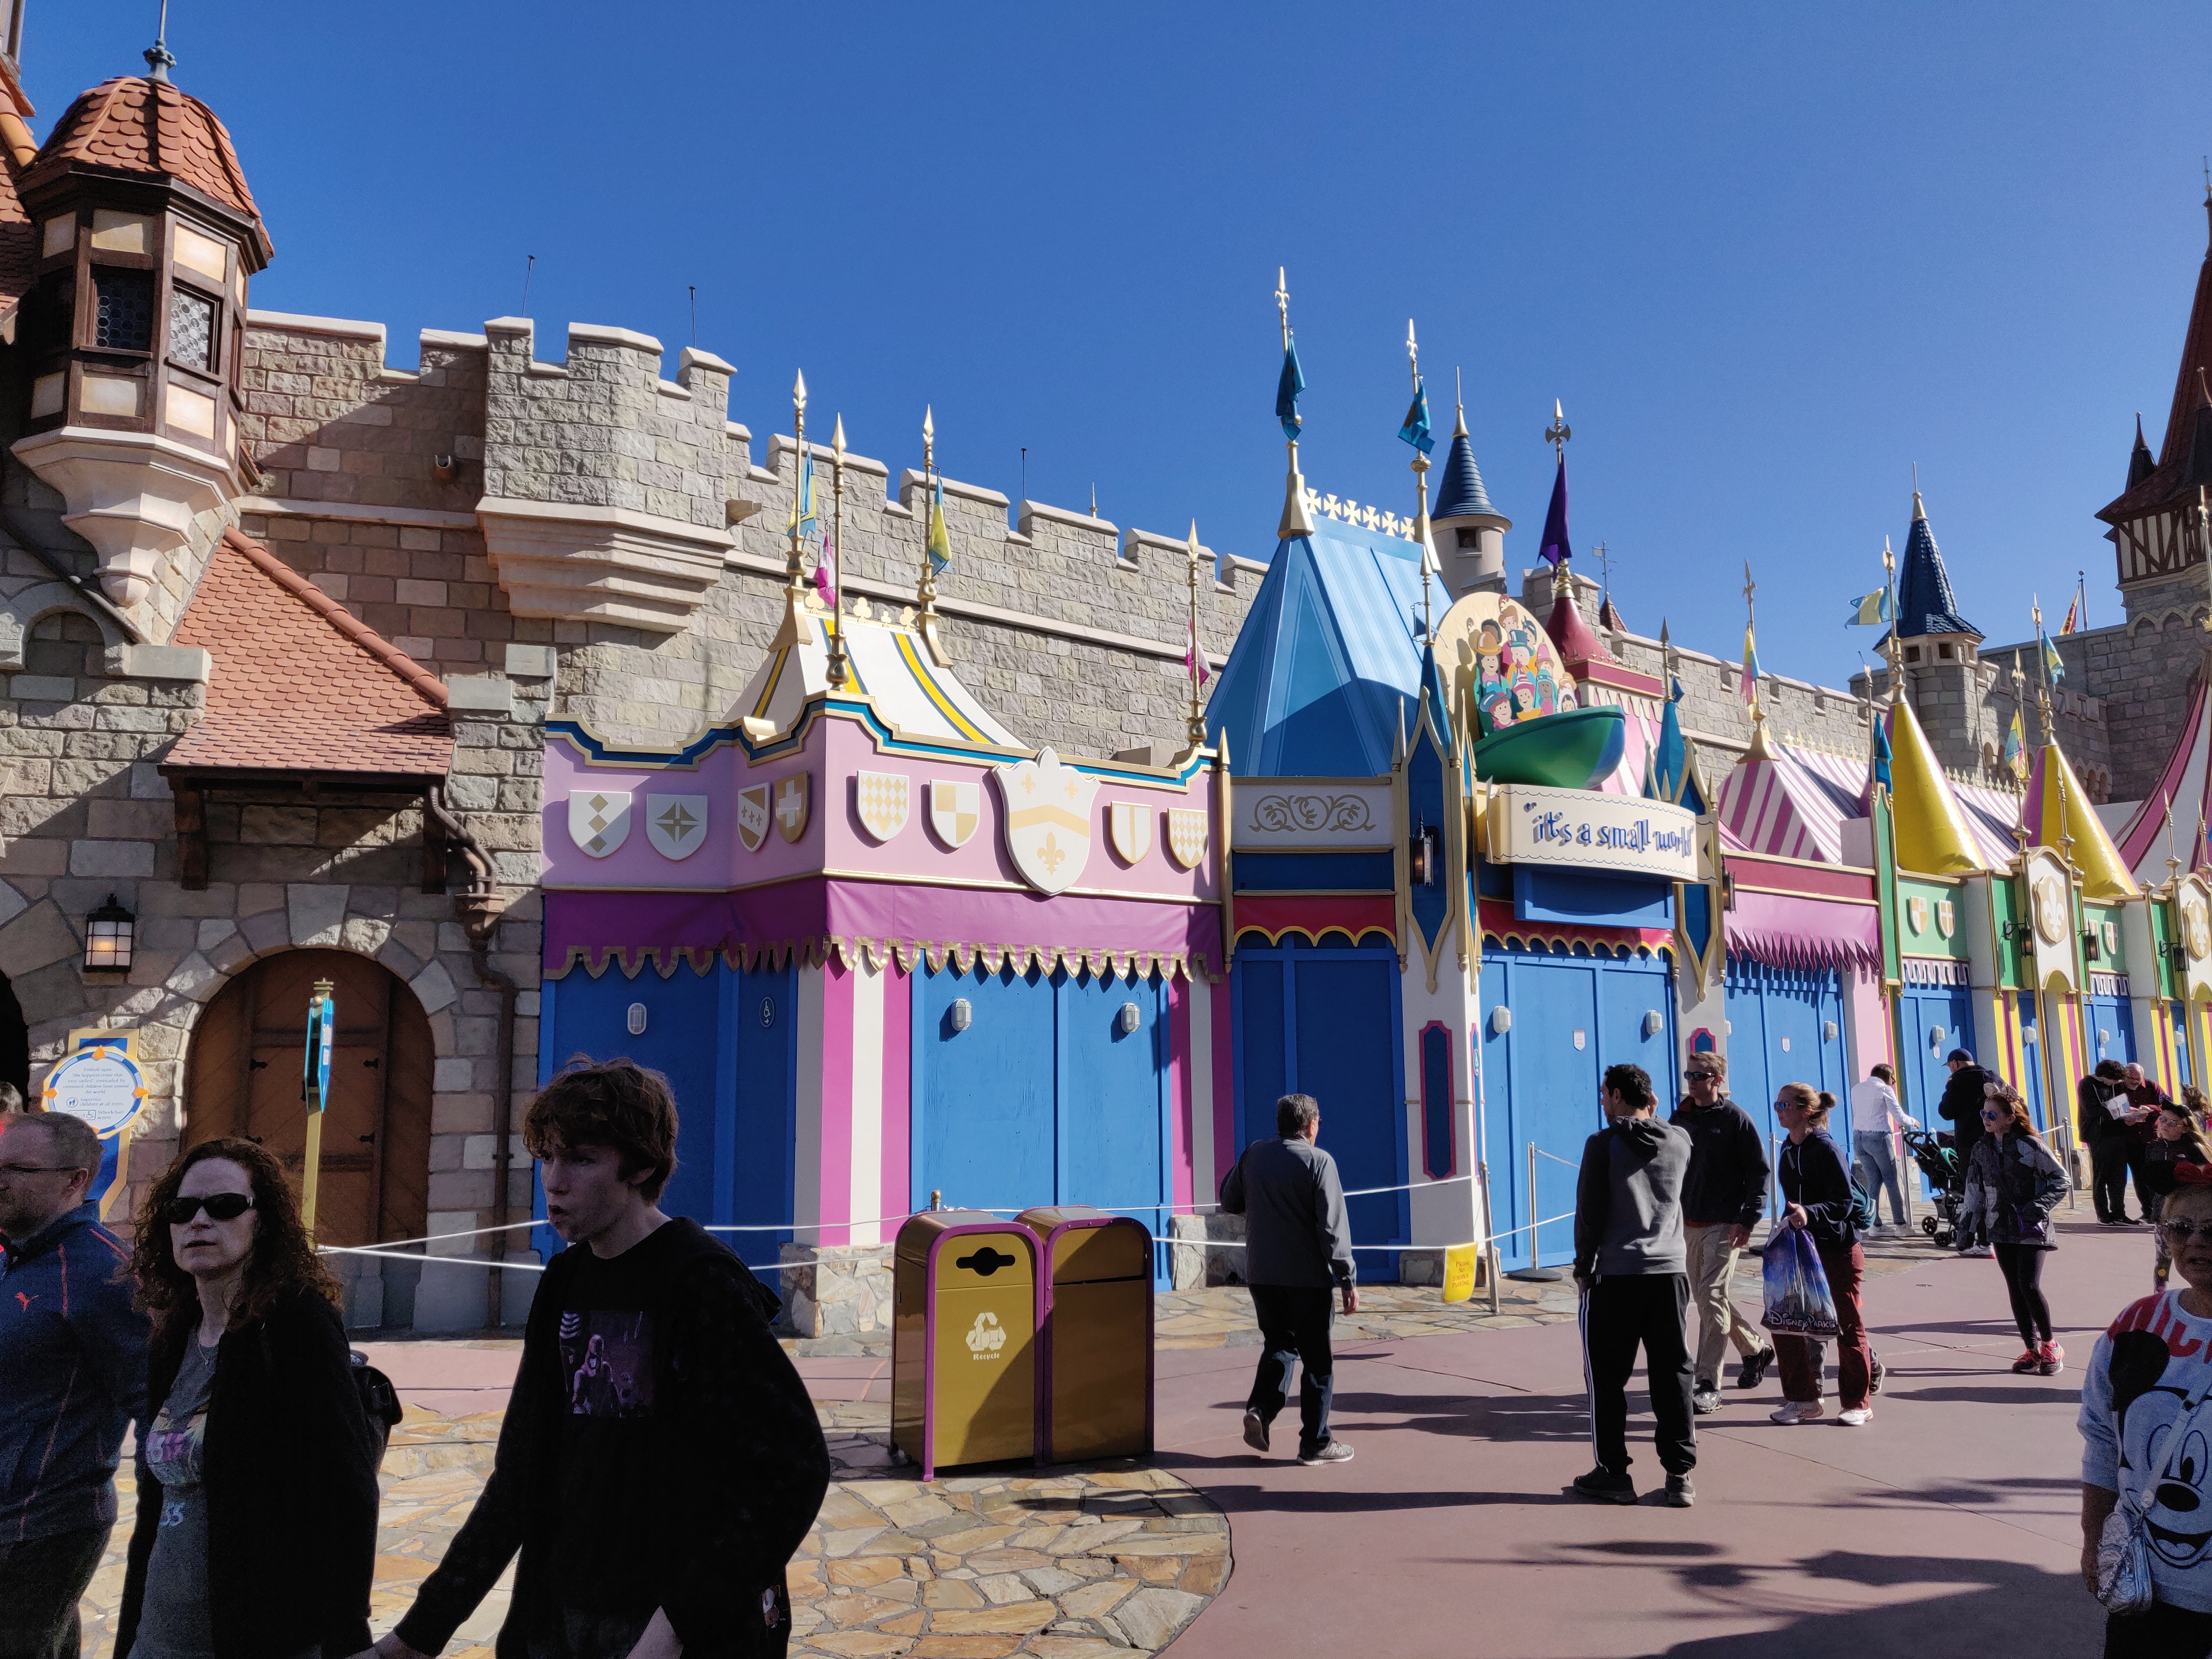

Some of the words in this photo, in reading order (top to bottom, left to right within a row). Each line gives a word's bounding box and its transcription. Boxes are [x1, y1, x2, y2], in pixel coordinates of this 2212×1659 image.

[1576, 823, 1591, 846] a
[1595, 819, 1651, 854] small
[973, 1352, 999, 1360] Recycle
